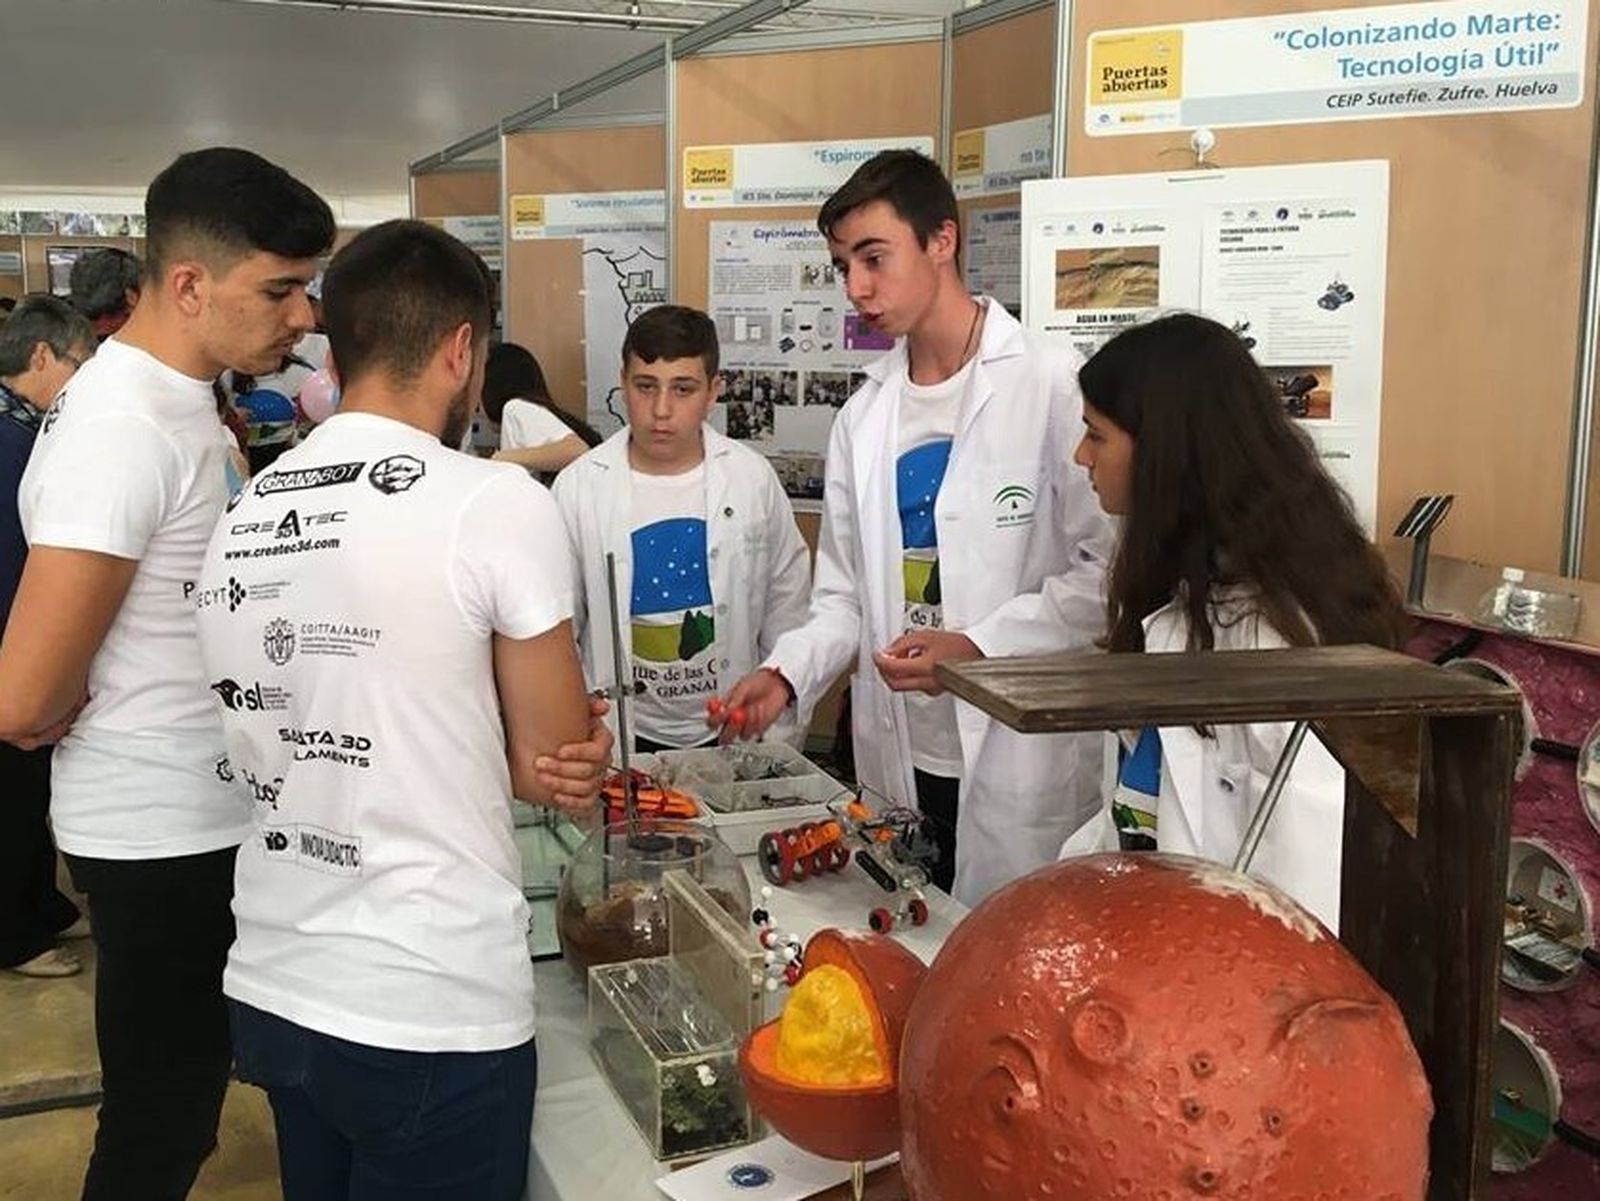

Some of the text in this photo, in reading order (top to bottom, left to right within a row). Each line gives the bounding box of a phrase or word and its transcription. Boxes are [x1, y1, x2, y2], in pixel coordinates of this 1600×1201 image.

[1467, 12, 1561, 37] Marte:
[1102, 65, 1168, 81] Puertas
[1337, 48, 1484, 78] Tecnología
[1102, 78, 1168, 93] abiertas
[1436, 85, 1489, 103] Zufre.
[1495, 81, 1558, 99] Huelva
[225, 538, 341, 561] www.createc3d.com
[664, 667, 680, 681] de
[684, 667, 704, 680] las
[294, 749, 371, 769] LAMENTS
